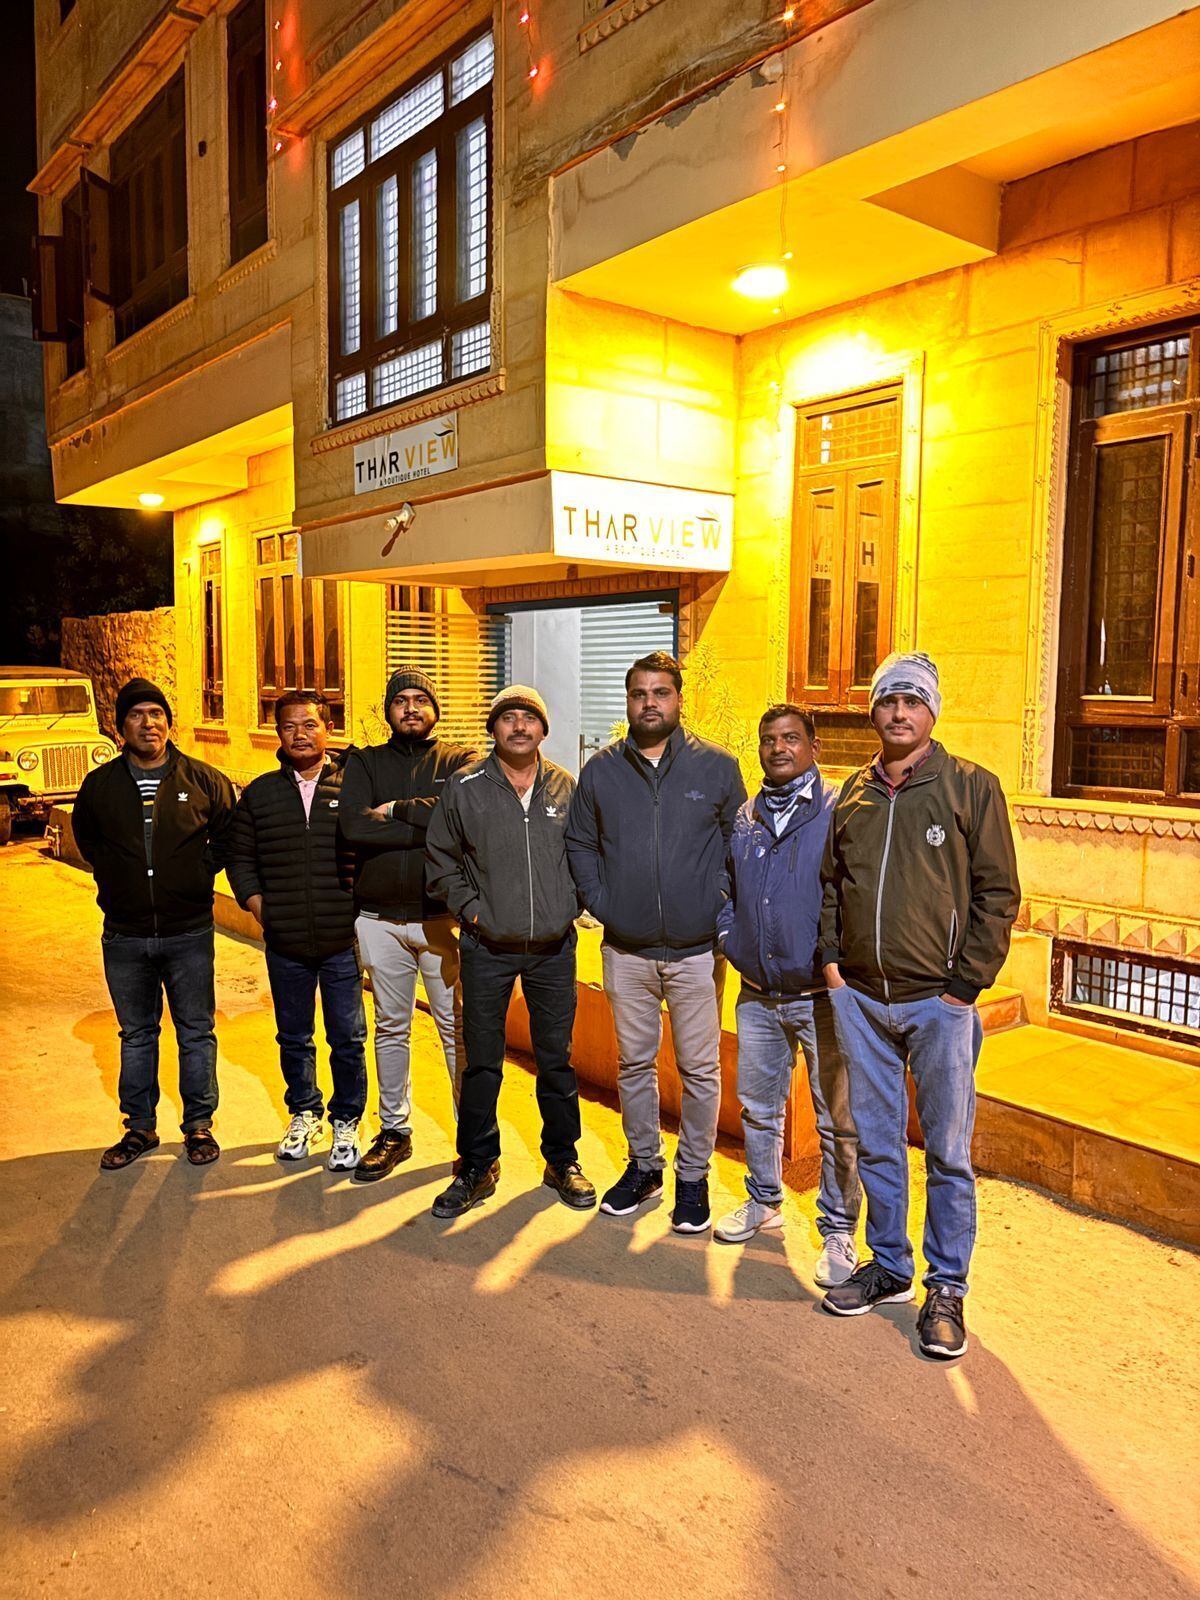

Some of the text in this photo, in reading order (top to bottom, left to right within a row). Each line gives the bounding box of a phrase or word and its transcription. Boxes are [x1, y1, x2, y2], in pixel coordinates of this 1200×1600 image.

[356, 435, 456, 483] THAR VIEW
[563, 506, 721, 549] THAR VIEW
